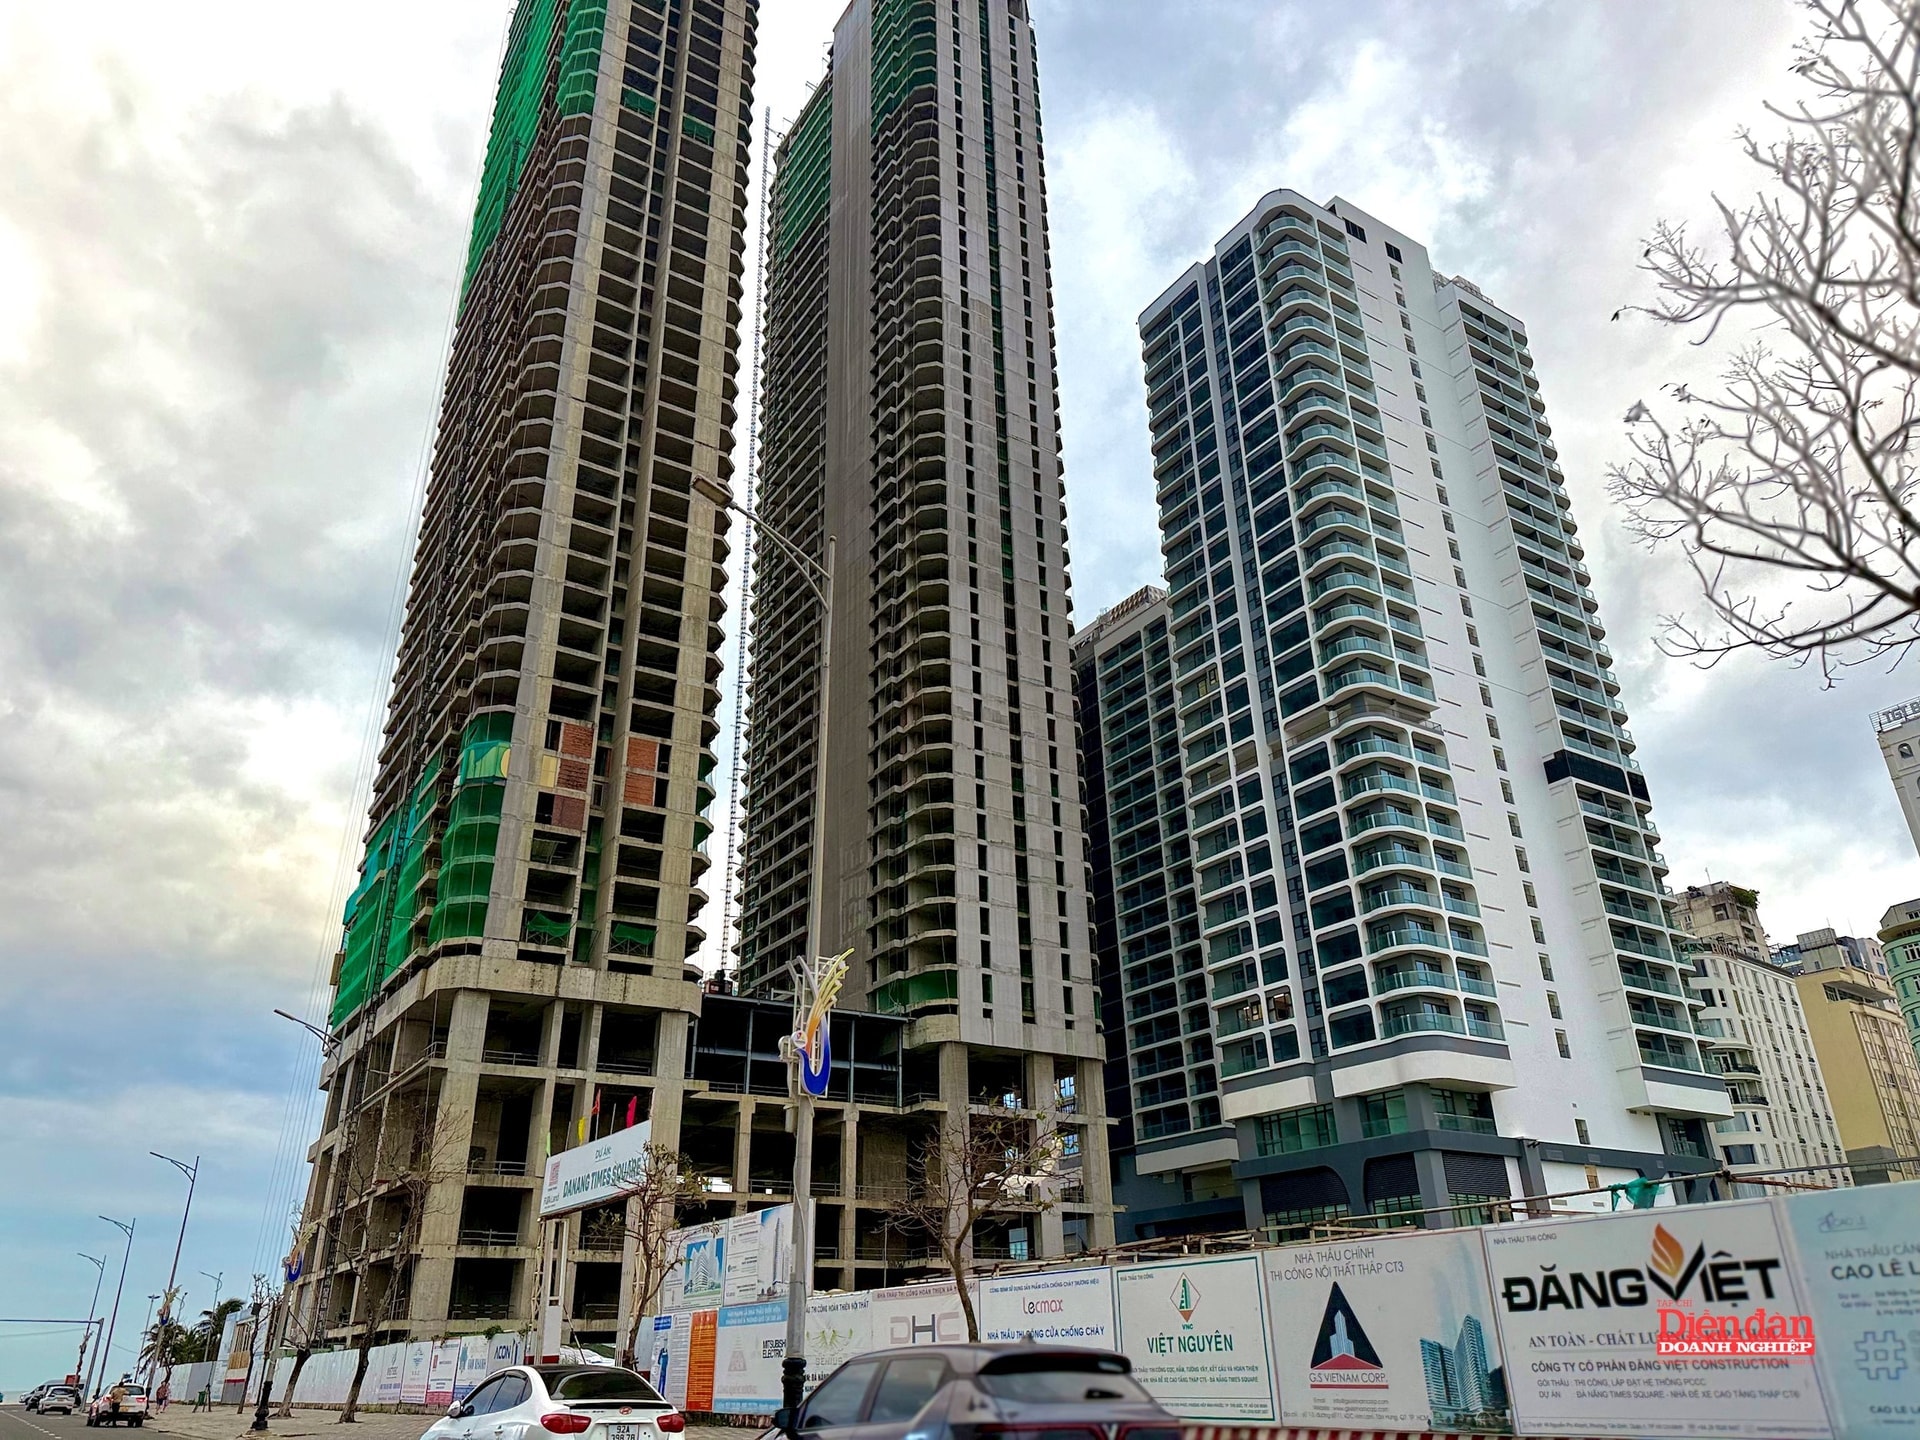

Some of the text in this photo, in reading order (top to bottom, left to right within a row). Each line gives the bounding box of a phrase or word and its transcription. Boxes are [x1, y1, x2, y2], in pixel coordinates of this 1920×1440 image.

[563, 1157, 642, 1198] DANANG TIMES SQUARE
[1494, 1237, 1507, 1245] NHÀ
[1538, 1233, 1557, 1241] CÔNG
[1295, 1245, 1375, 1264] NHÀ THẦU CHÍNH
[1270, 1270, 1282, 1281] THI
[1284, 1267, 1313, 1281] CÔNG
[1315, 1264, 1332, 1281] NỘI
[1333, 1261, 1356, 1277] THẤT
[1385, 1261, 1404, 1274] CT3
[1831, 1264, 1874, 1281] CAO
[1878, 1258, 1904, 1277] LÊ
[890, 1311, 961, 1345] DHC
[987, 1331, 999, 1340] NHÀ
[1060, 1325, 1084, 1337] CHỐNG
[1085, 1324, 1105, 1336] CHÁY
[762, 1339, 786, 1349] MITSUBISH
[1146, 1330, 1233, 1357] VIỆT NGUYÊN
[1529, 1336, 1546, 1348] AN
[1548, 1332, 1586, 1347] TOÀN
[1596, 1329, 1635, 1346] CHẤT
[762, 1349, 783, 1359] ELECTRIC
[1531, 1360, 1560, 1373] CÔNG
[1563, 1361, 1576, 1372] TY
[1597, 1358, 1626, 1372] PHẦN
[1629, 1358, 1660, 1371] ĐĂNG
[1664, 1359, 1689, 1373] VIỆT
[1692, 1358, 1789, 1371] CONSTRUCTION
[1325, 1372, 1359, 1383] VIETNAM
[1360, 1372, 1388, 1383] CORP.
[1610, 1390, 1631, 1398] TIMES
[1633, 1390, 1665, 1399] SQUARE
